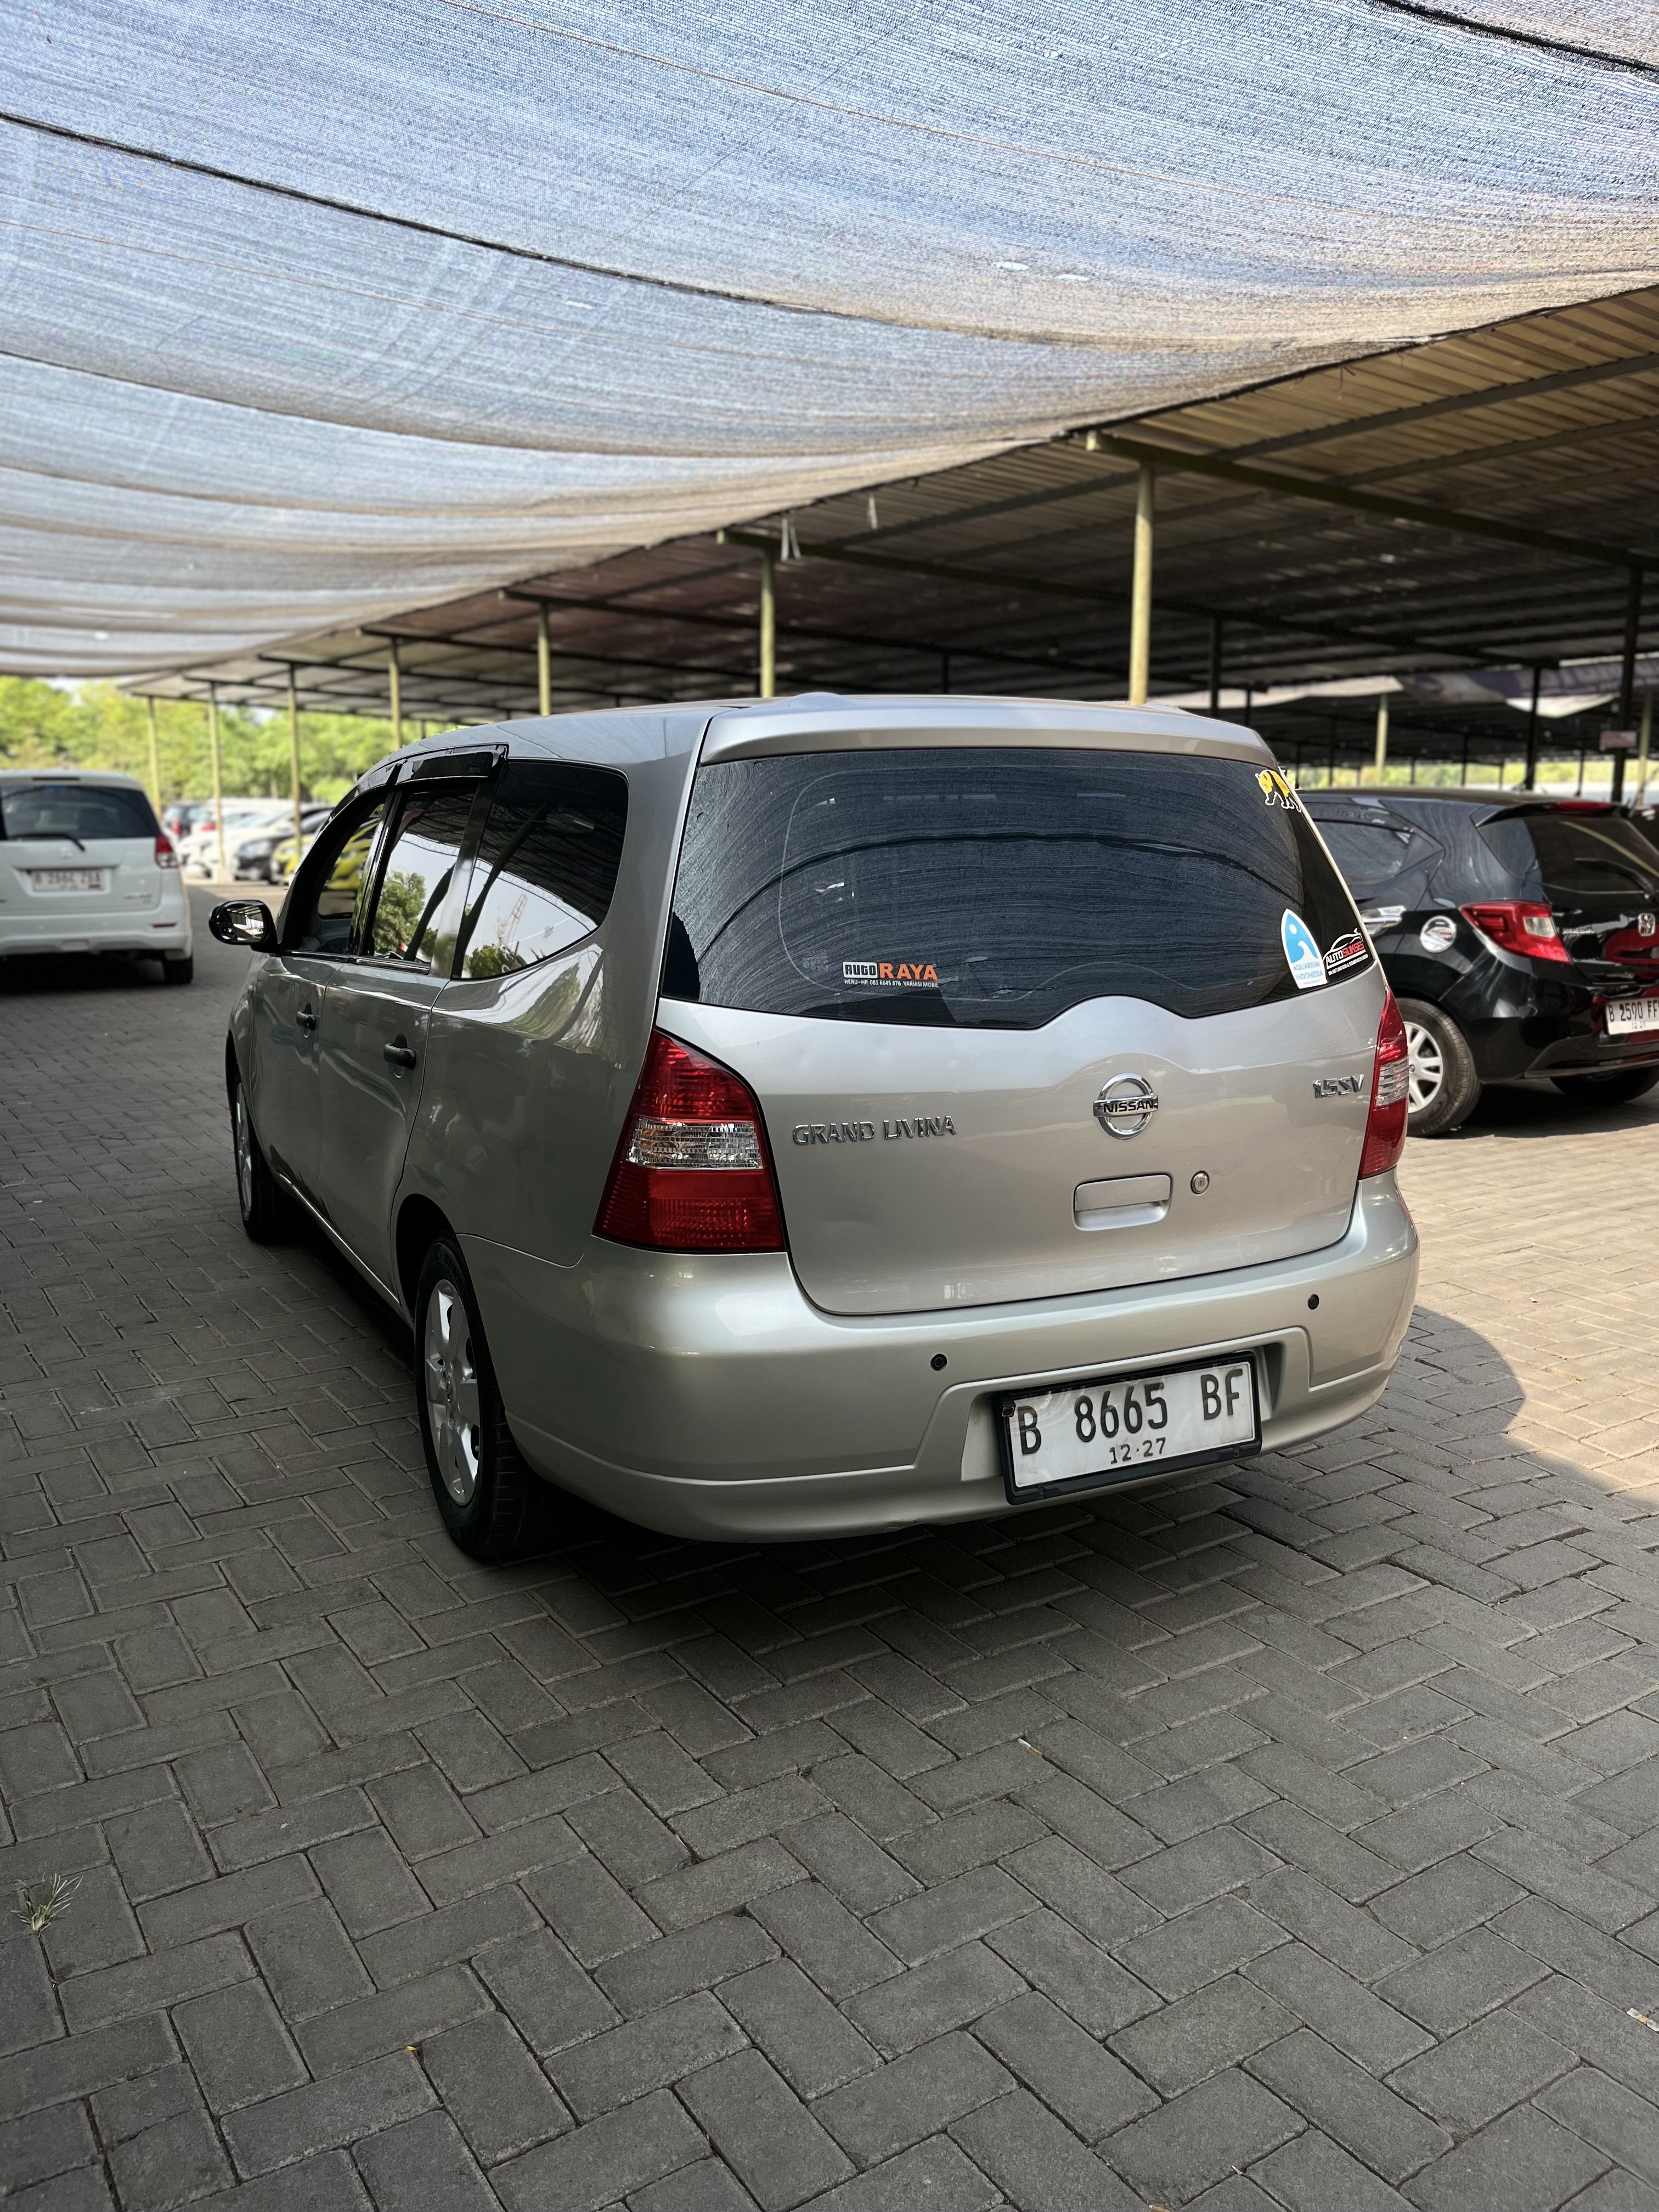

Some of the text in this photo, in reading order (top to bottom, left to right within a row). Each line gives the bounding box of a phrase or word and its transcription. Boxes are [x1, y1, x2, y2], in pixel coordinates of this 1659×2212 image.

[879, 963, 938, 980] RAYA
[1293, 961, 1321, 971] AQUARIUM
[1295, 970, 1323, 980] INDONESIA
[1608, 1000, 1659, 1022] B 2590 FF
[1103, 1100, 1153, 1113] NISSAN
[793, 1115, 957, 1145] GRAND LIVINA
[1017, 1368, 1243, 1455] B 8665 BF
